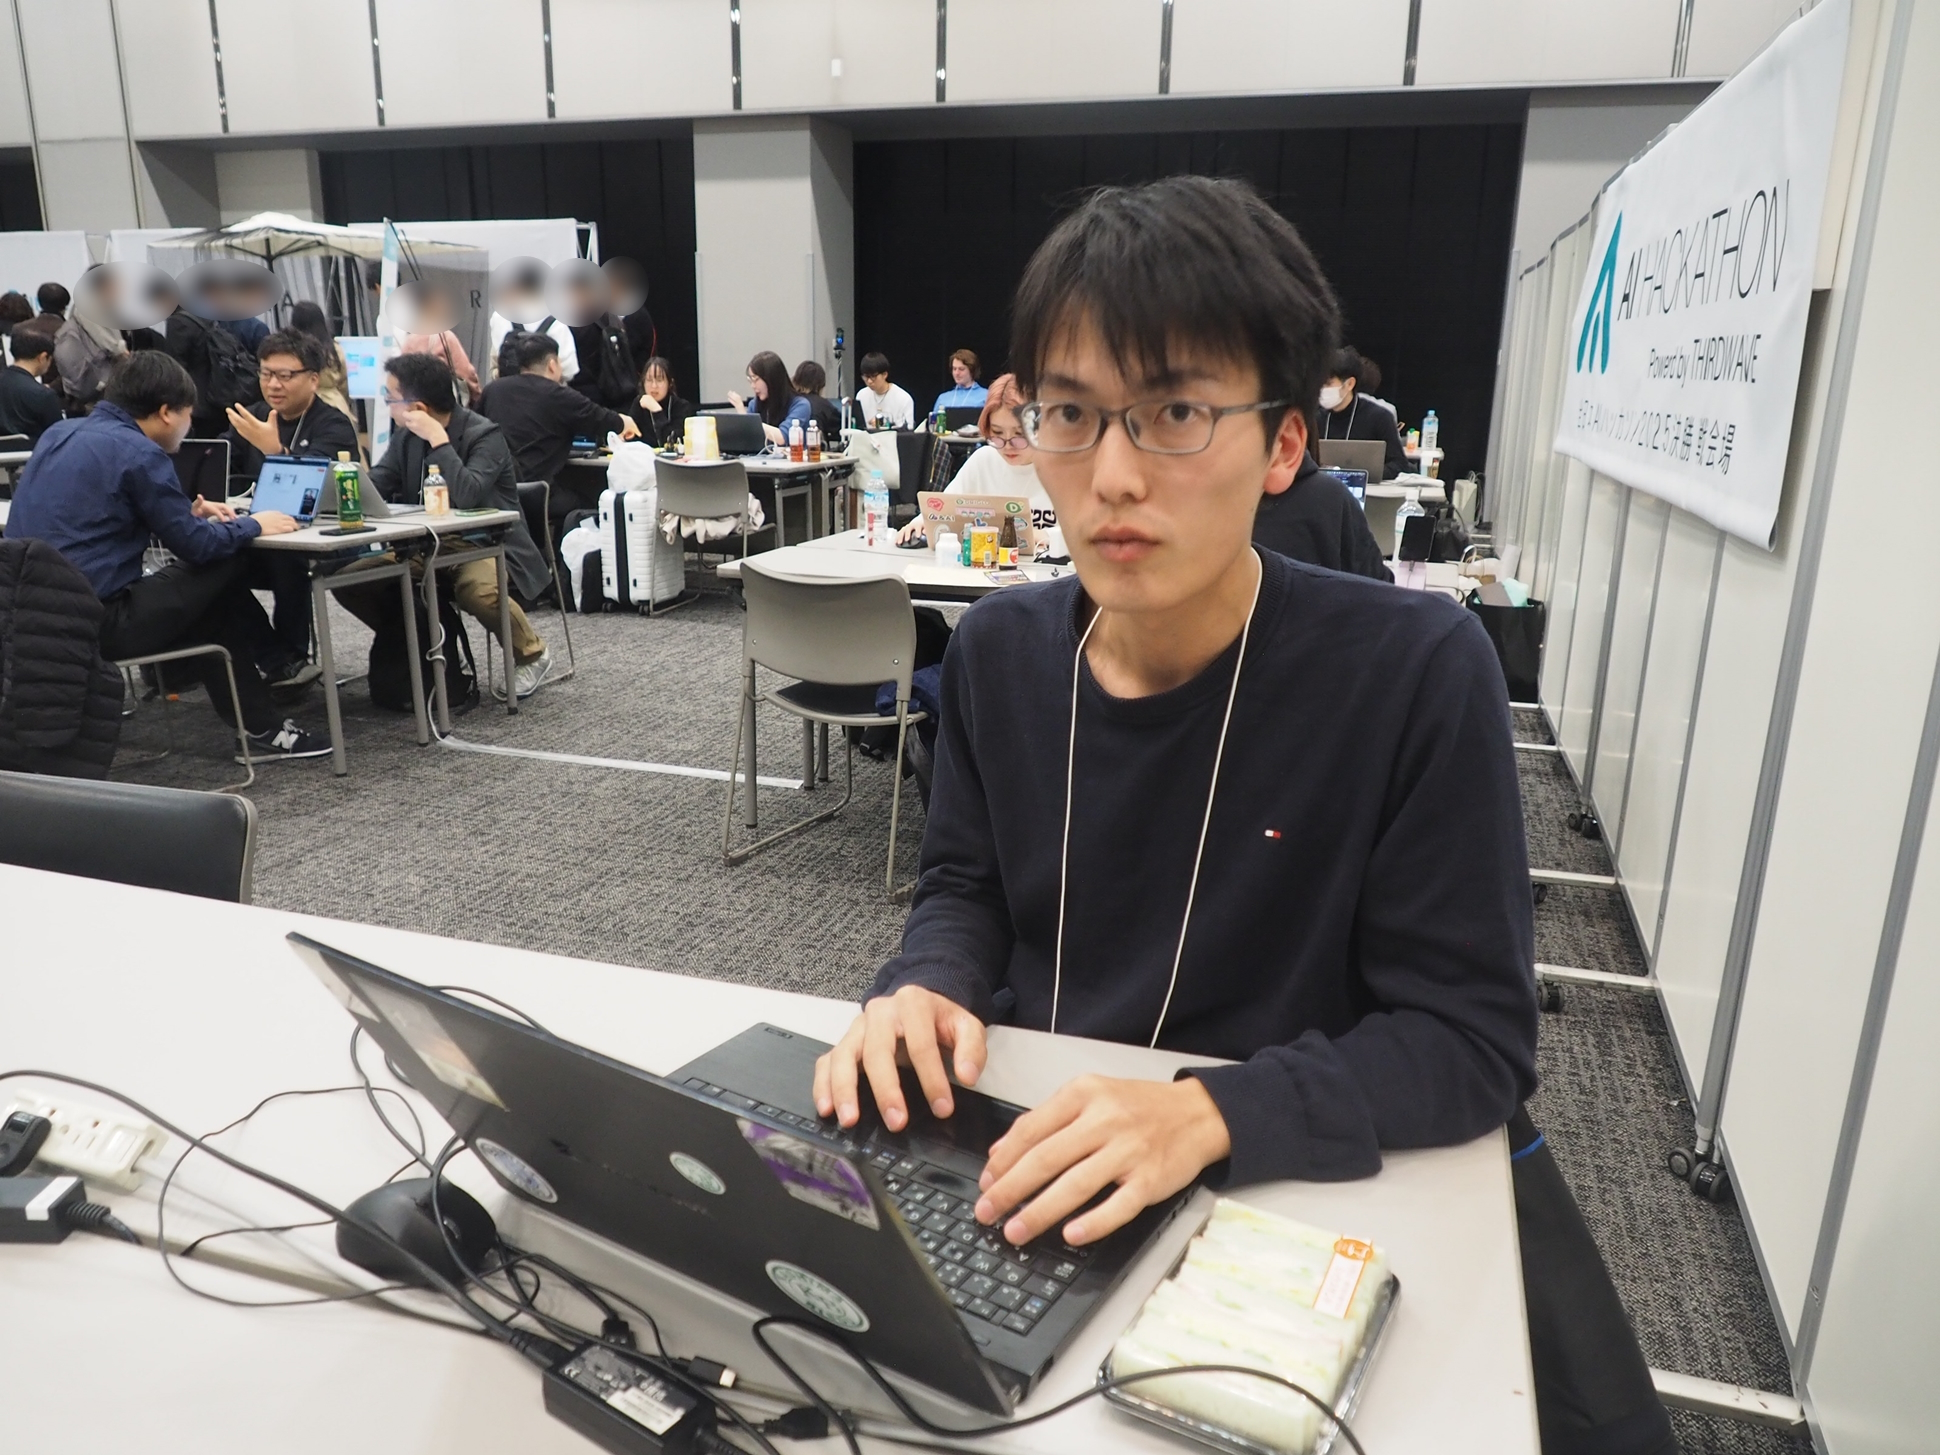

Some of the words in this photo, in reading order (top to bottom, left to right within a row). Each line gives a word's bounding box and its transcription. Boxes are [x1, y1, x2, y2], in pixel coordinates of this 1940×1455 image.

[1617, 248, 1643, 321] AI
[1637, 178, 1790, 318] HACKATHON
[470, 289, 482, 308] R
[1677, 346, 1690, 388] by
[1690, 334, 1761, 384] THIRDWAVE
